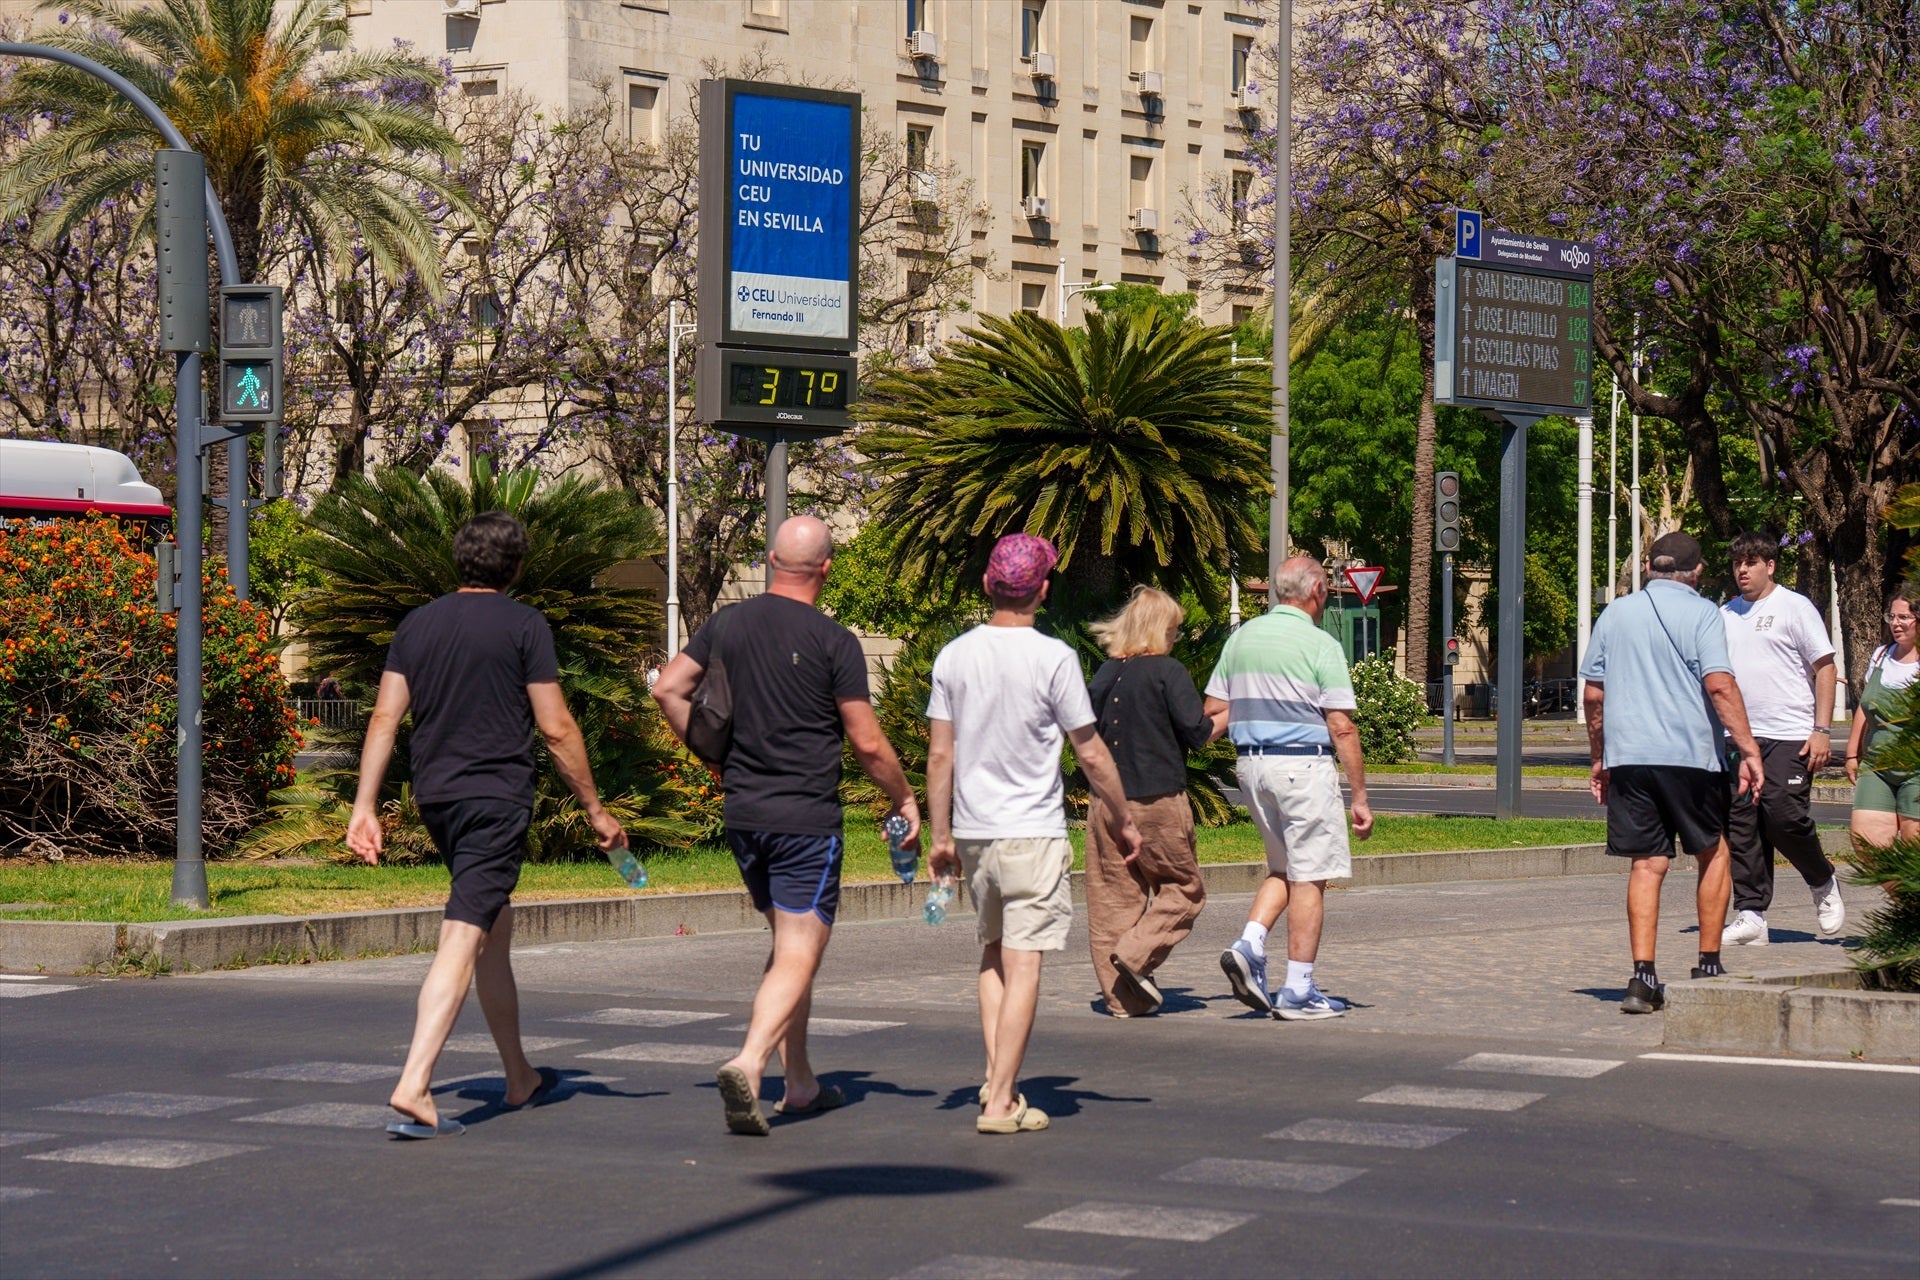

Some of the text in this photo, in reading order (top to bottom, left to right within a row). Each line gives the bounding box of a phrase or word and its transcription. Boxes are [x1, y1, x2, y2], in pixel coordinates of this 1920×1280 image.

[740, 133, 761, 151] TU
[740, 159, 844, 185] UNIVERSIDAD
[739, 185, 771, 203] CEU
[738, 209, 824, 233] EN SEVILLA
[1462, 219, 1475, 249] P
[1490, 235, 1550, 252] Ayuntamiento de Sevilla
[752, 288, 841, 309] CEU Universidad
[1476, 271, 1589, 310] SAN BERNARDO 184
[752, 308, 804, 323] Fernando III
[1474, 305, 1503, 333] JOSE
[1506, 308, 1558, 339] LAGUILLO
[1474, 337, 1588, 374] ESCUELAS PIAS 76
[1473, 369, 1588, 405] IMAGEN 37
